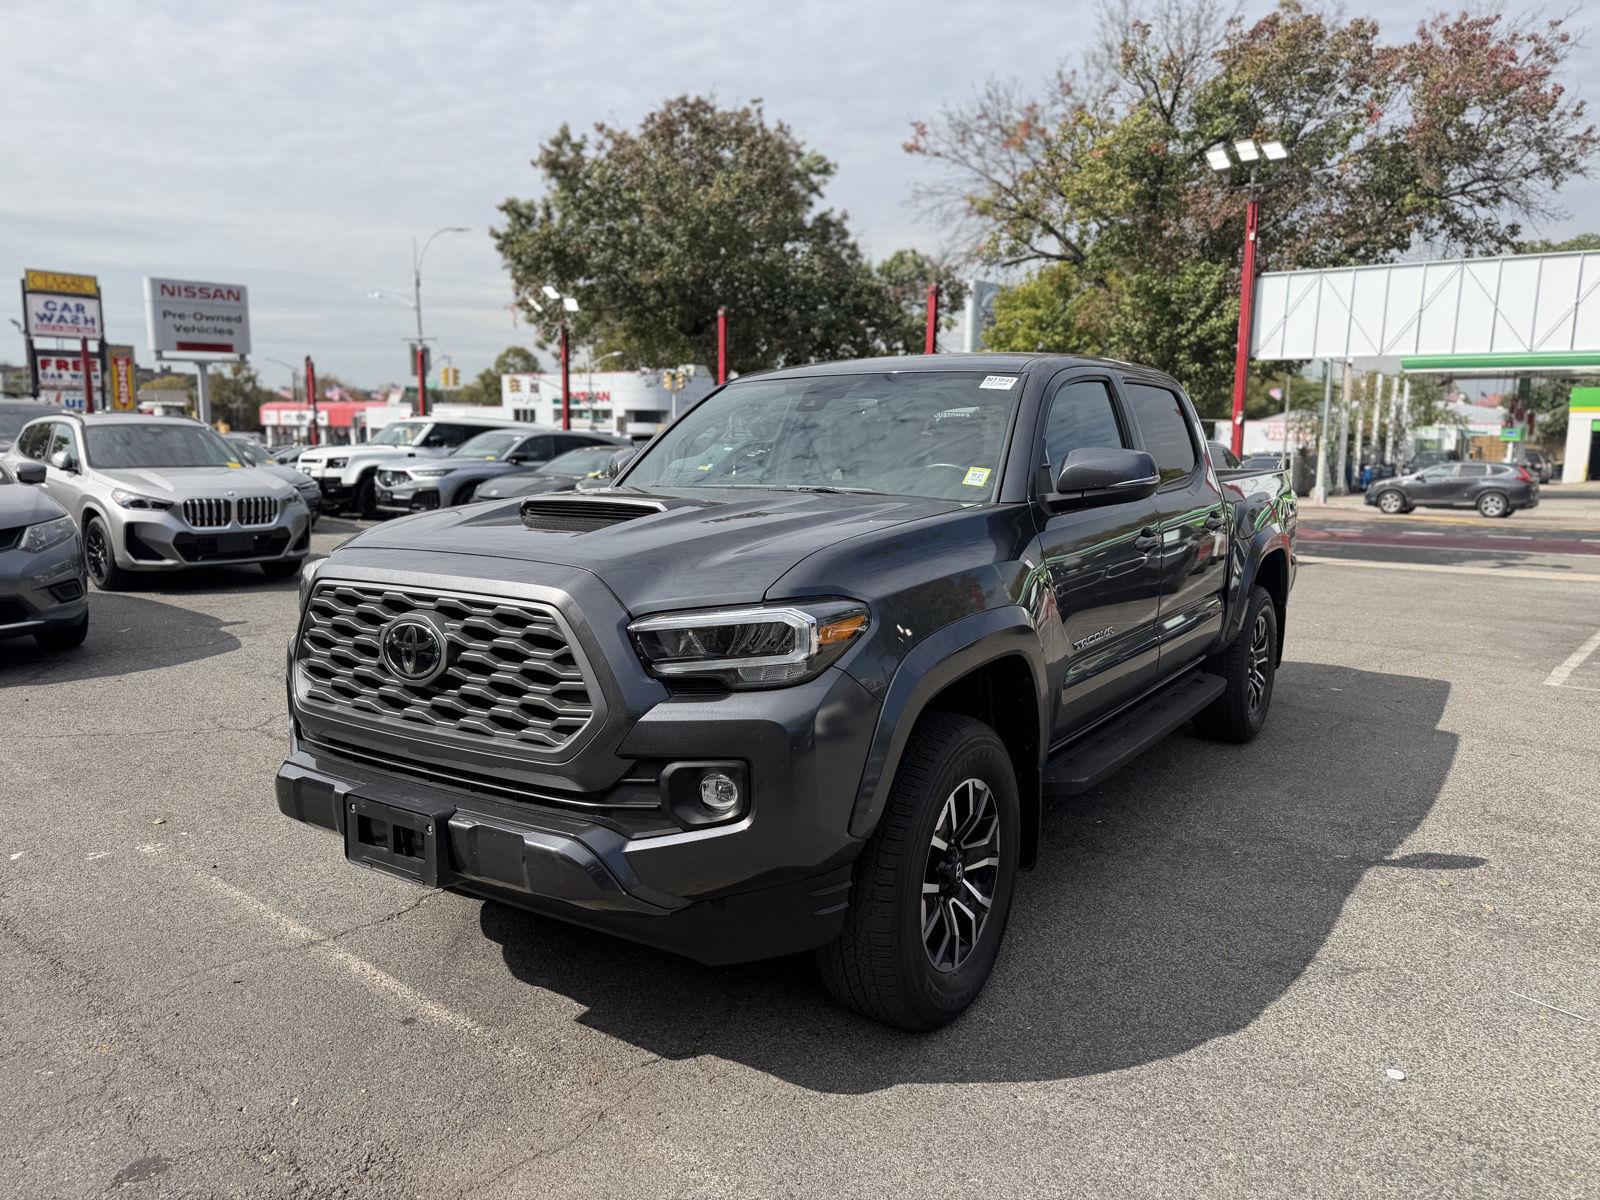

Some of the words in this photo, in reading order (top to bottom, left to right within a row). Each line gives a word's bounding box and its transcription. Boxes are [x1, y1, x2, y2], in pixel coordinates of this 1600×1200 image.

[160, 284, 241, 302] NISSAN
[43, 300, 86, 314] CAR
[35, 312, 95, 326] WASH
[162, 310, 242, 323] Pre-Owned
[173, 324, 234, 335] Vehicles
